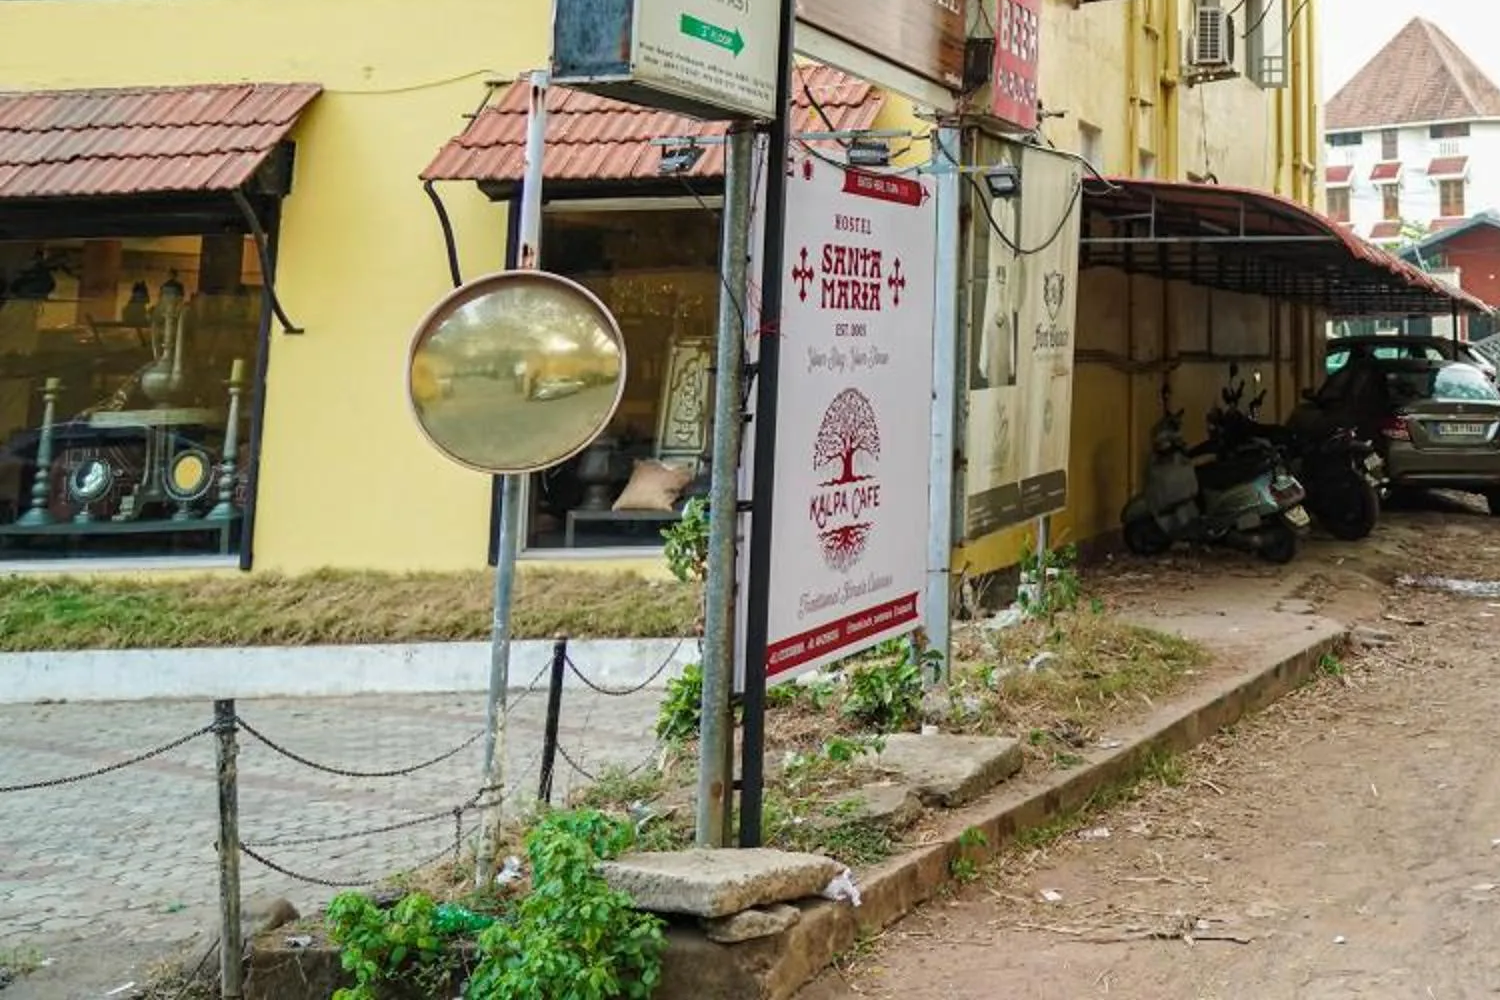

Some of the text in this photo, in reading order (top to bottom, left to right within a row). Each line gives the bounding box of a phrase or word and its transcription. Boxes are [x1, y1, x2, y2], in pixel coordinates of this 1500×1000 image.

[834, 213, 873, 235] HOSTEL
[822, 244, 882, 279] SANTA
[821, 278, 881, 312] MARIA
[809, 485, 881, 529] KALPA CAFE
